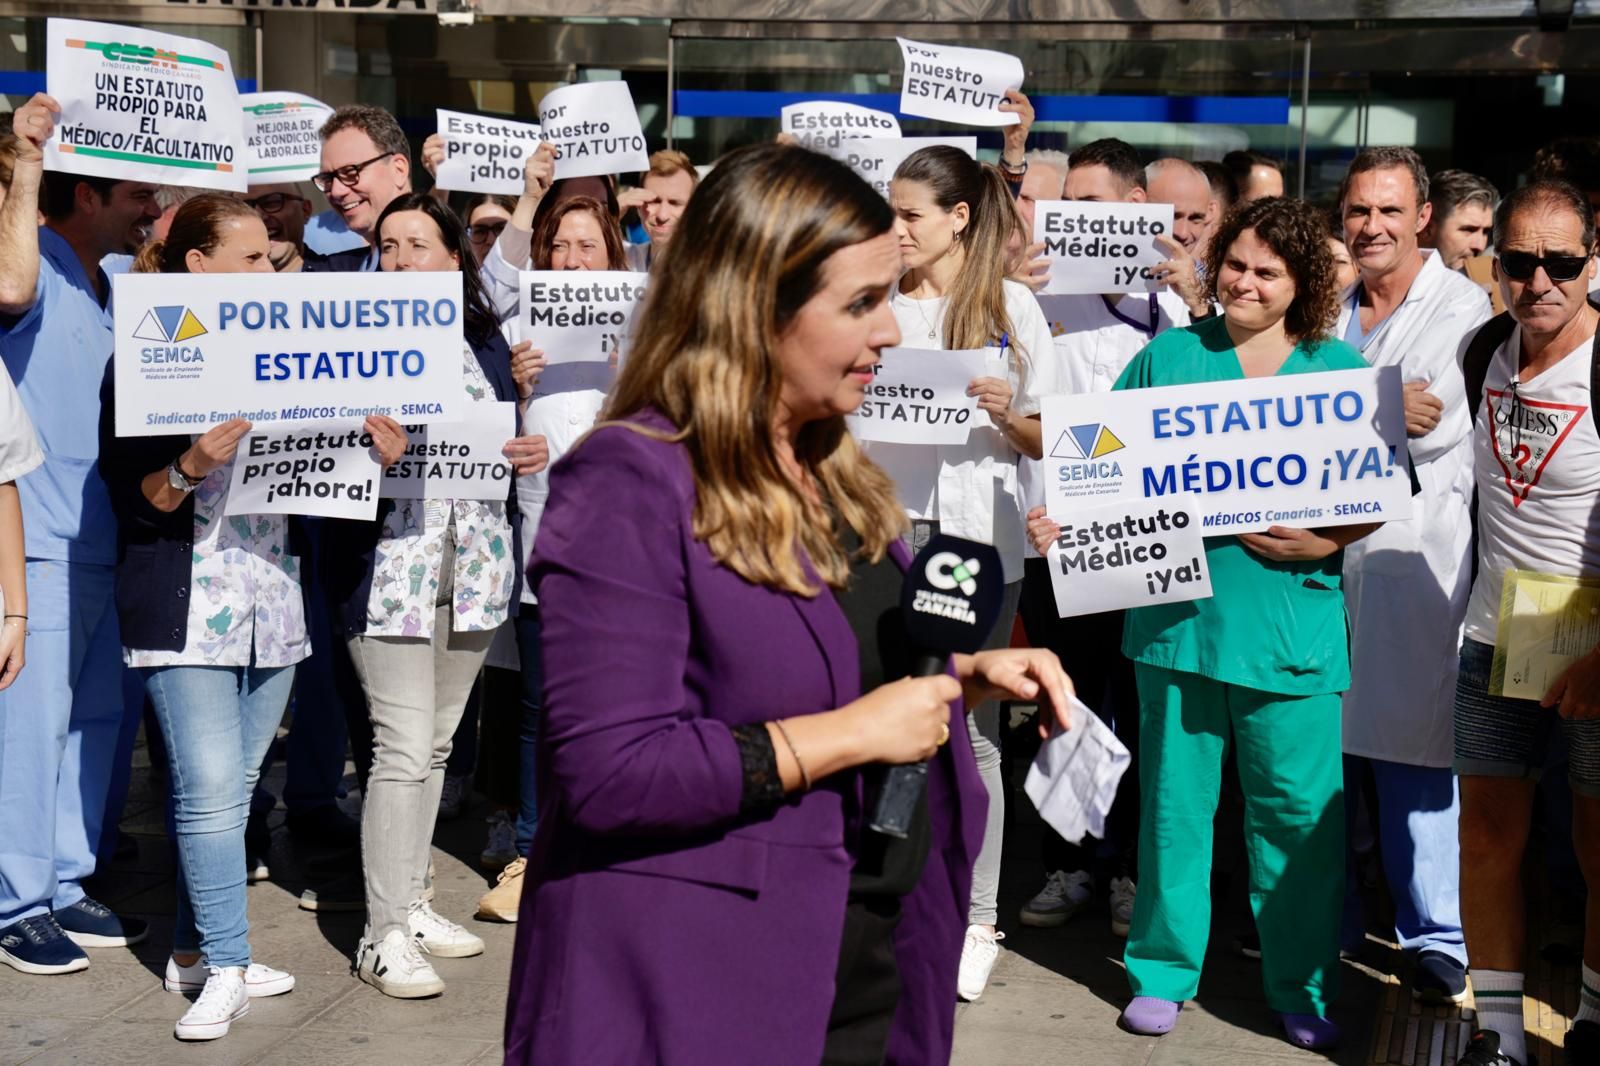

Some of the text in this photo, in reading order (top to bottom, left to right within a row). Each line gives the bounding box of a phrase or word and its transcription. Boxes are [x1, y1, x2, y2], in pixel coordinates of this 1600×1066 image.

[102, 62, 140, 72] SINDICATO
[910, 60, 983, 86] nuestro
[95, 72, 203, 102] UN ESTATUTO
[96, 93, 207, 121] PROPIO PARA
[140, 117, 159, 135] EL
[257, 120, 314, 134] MEJORA DE
[791, 111, 893, 130] Estatuto
[61, 123, 234, 163] MÉDICO/FACULTATIVO
[248, 131, 321, 147] AS CONDICON
[448, 139, 523, 161] propio
[553, 135, 643, 160] STATUTO
[257, 144, 318, 159] LABORALES
[470, 161, 526, 182] ¡aho
[1045, 212, 1165, 236] Estatuto
[1044, 236, 1138, 258] Médico
[531, 282, 647, 303] Estatuto
[219, 298, 457, 330] POR NUESTRO
[531, 305, 626, 327] Médico
[140, 346, 205, 363] SEMCA
[255, 349, 426, 382] ESTATUTO
[863, 384, 935, 401] uestro
[146, 403, 443, 426] Sindicato Empleados MÉDICOS Canarias SEMCA
[855, 401, 970, 425] STATUTO
[1152, 390, 1364, 440] ESTATUTO
[248, 428, 375, 458] Estatuto
[403, 440, 471, 457] uestro
[243, 453, 336, 484] propio
[385, 461, 507, 480] ESTATUTO
[1059, 461, 1123, 482] SEMCA
[1143, 445, 1397, 498] MÉDICO ¡YA!
[267, 479, 372, 503] ¡ahora!
[1202, 501, 1382, 528] MÉDICOS Canarias SEMCA
[1057, 508, 1190, 550] Estatuto
[1060, 540, 1168, 576] Médico
[1146, 557, 1202, 596] ¡ya!
[912, 599, 976, 625] CANARIA
